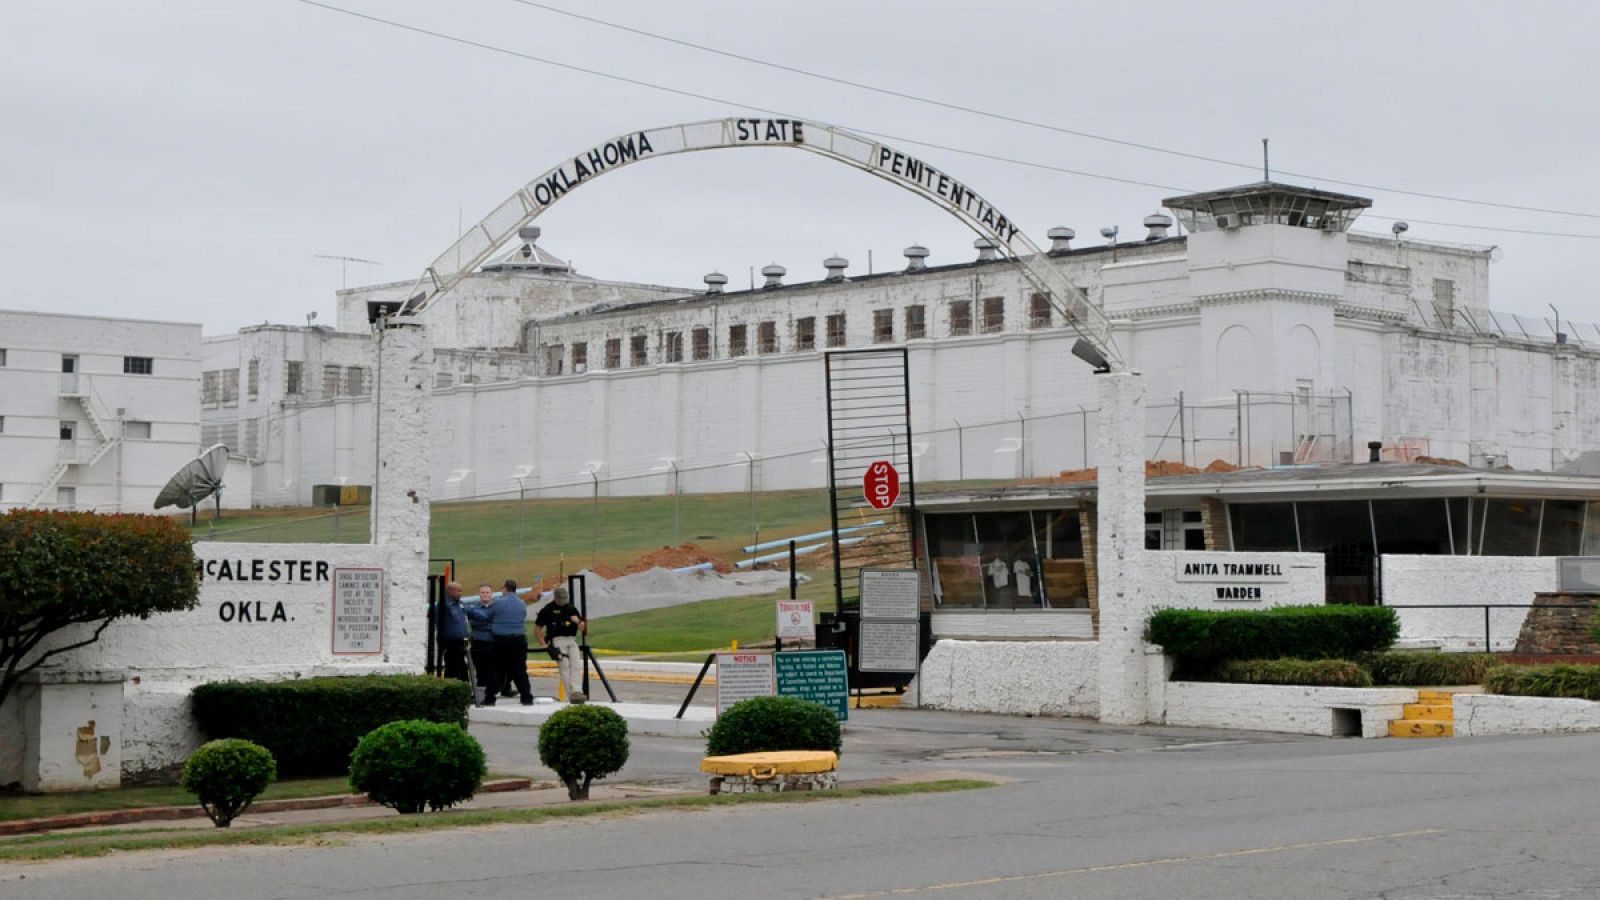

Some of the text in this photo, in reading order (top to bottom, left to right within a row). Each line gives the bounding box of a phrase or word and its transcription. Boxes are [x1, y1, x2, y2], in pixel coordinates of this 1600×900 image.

[535, 119, 1019, 243] OKLAHOMA STATE PENITENTIARY
[874, 463, 889, 506] STOP
[1184, 563, 1283, 576] ANITA TRAMMELL
[1216, 587, 1261, 600] WARDEN
[219, 601, 296, 622] OKLA.
[734, 655, 757, 663] NOTICE
